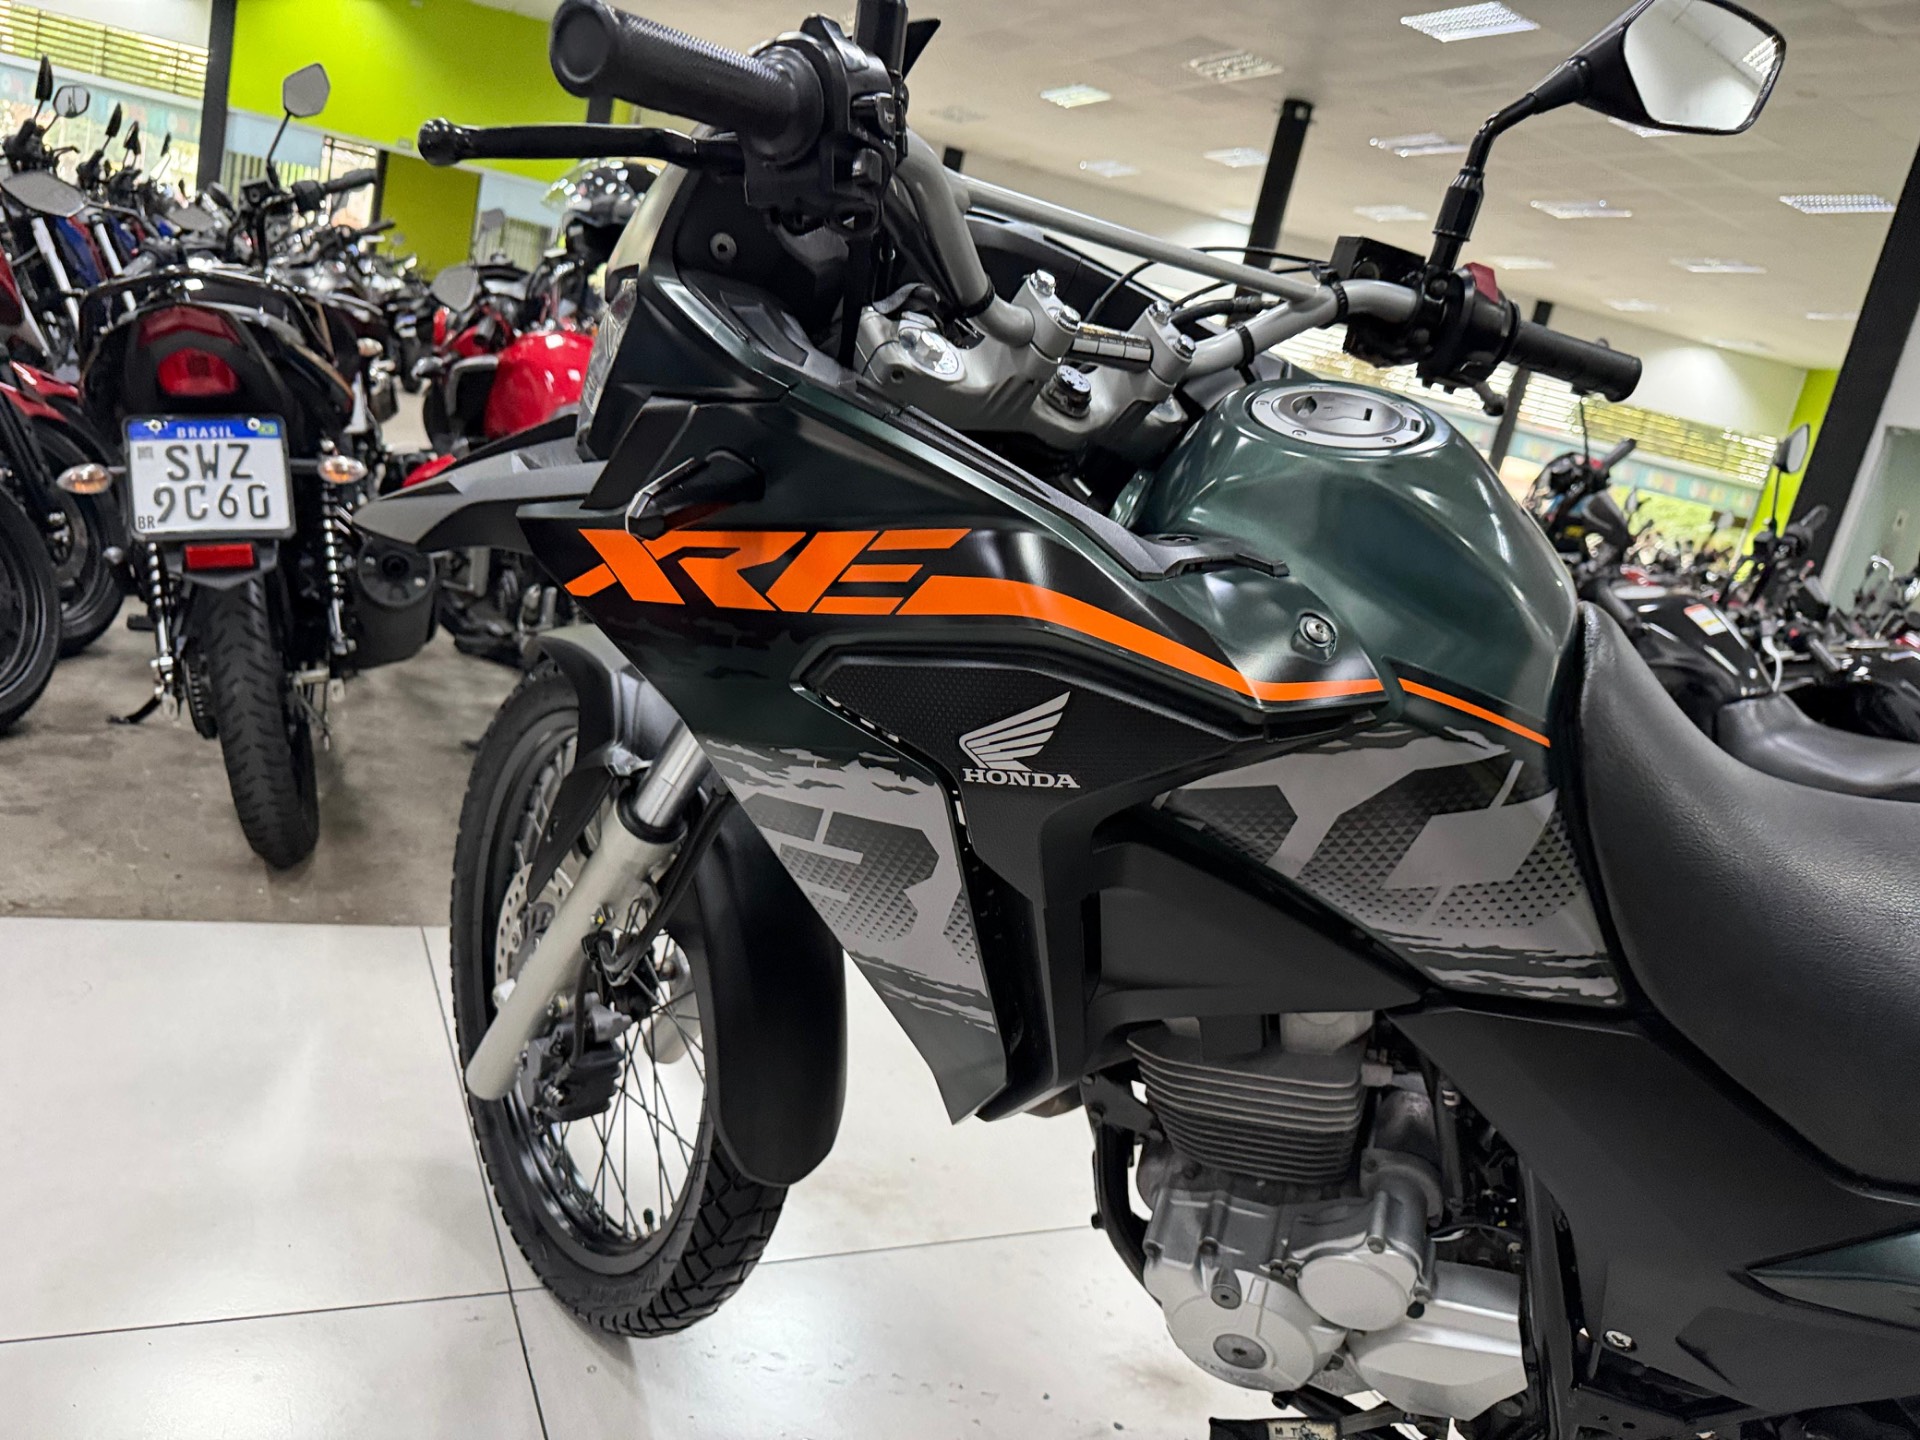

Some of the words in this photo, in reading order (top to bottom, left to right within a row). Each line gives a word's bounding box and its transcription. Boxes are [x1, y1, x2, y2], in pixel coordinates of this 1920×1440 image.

[176, 426, 235, 438] BRASIL
[165, 443, 253, 481] SWZ
[154, 484, 270, 523] 9C60
[137, 515, 156, 529] BR
[564, 528, 972, 616] XRE
[962, 768, 1081, 789] HONDA
